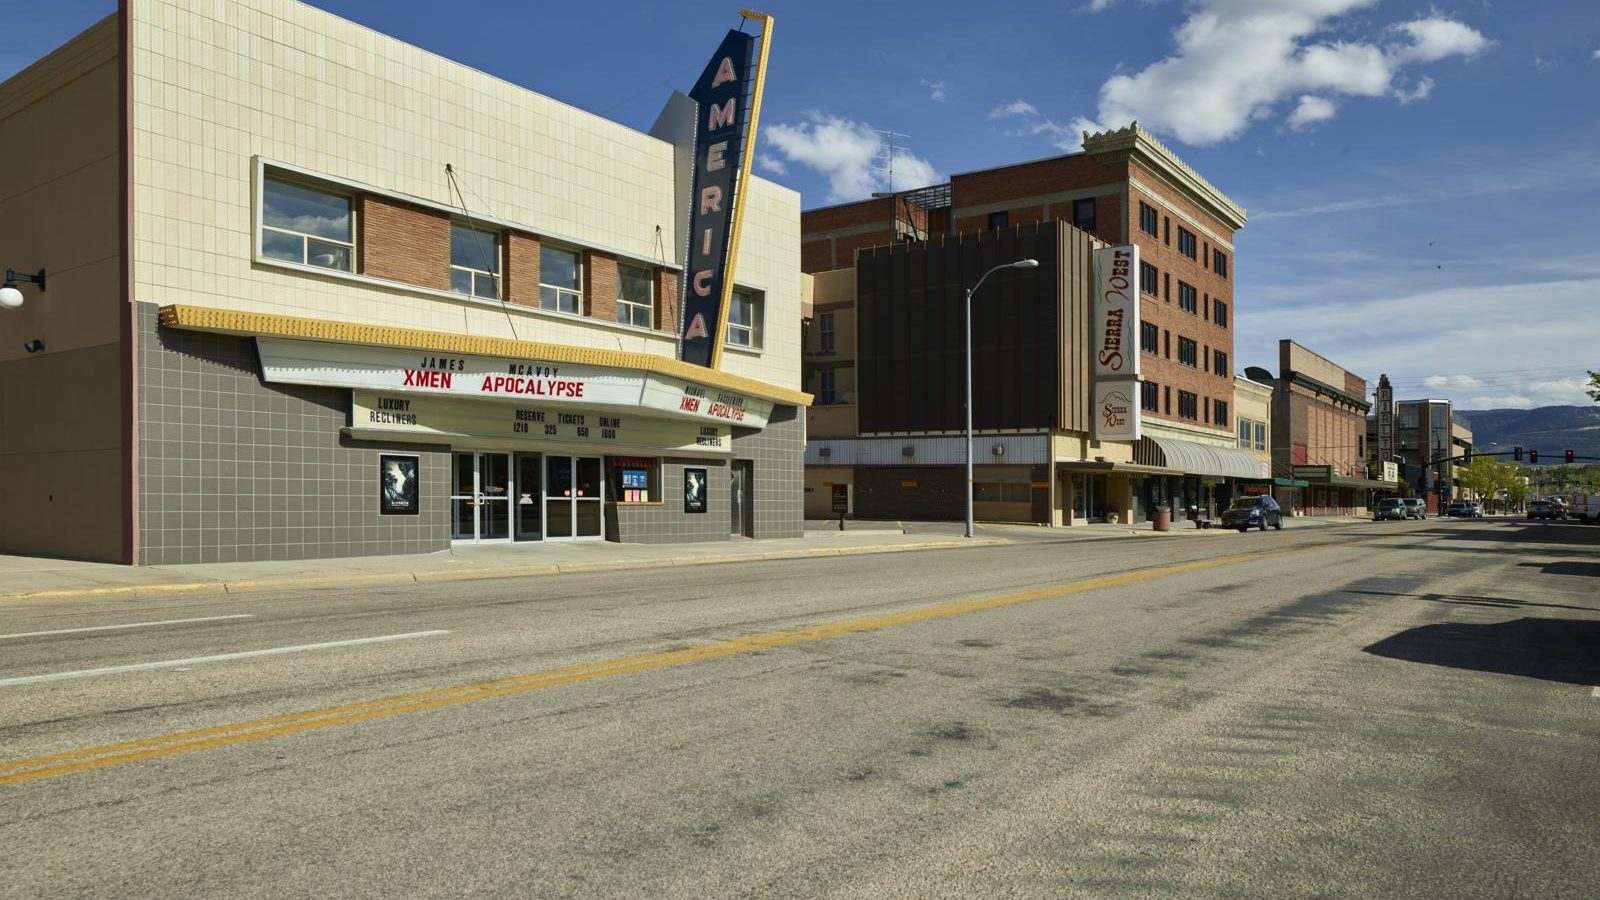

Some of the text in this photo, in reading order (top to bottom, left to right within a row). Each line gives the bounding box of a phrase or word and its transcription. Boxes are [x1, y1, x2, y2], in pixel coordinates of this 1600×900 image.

[684, 56, 737, 341] AMERICA
[1099, 250, 1131, 371] SIERRA WEST
[421, 356, 559, 378] JAMES MCAVOY
[403, 369, 584, 397] XMEN APOCALYPSE
[378, 397, 411, 411] LUXURY
[680, 396, 746, 421] XMEN APOCALYPSE
[1103, 403, 1127, 418] SIERRA
[370, 411, 417, 425] RECLINERS
[513, 422, 528, 433] 1210
[545, 424, 557, 435] 325
[515, 409, 620, 428] RESERVE TICKETS ONLINE
[1381, 389, 1391, 460] RIALTO
